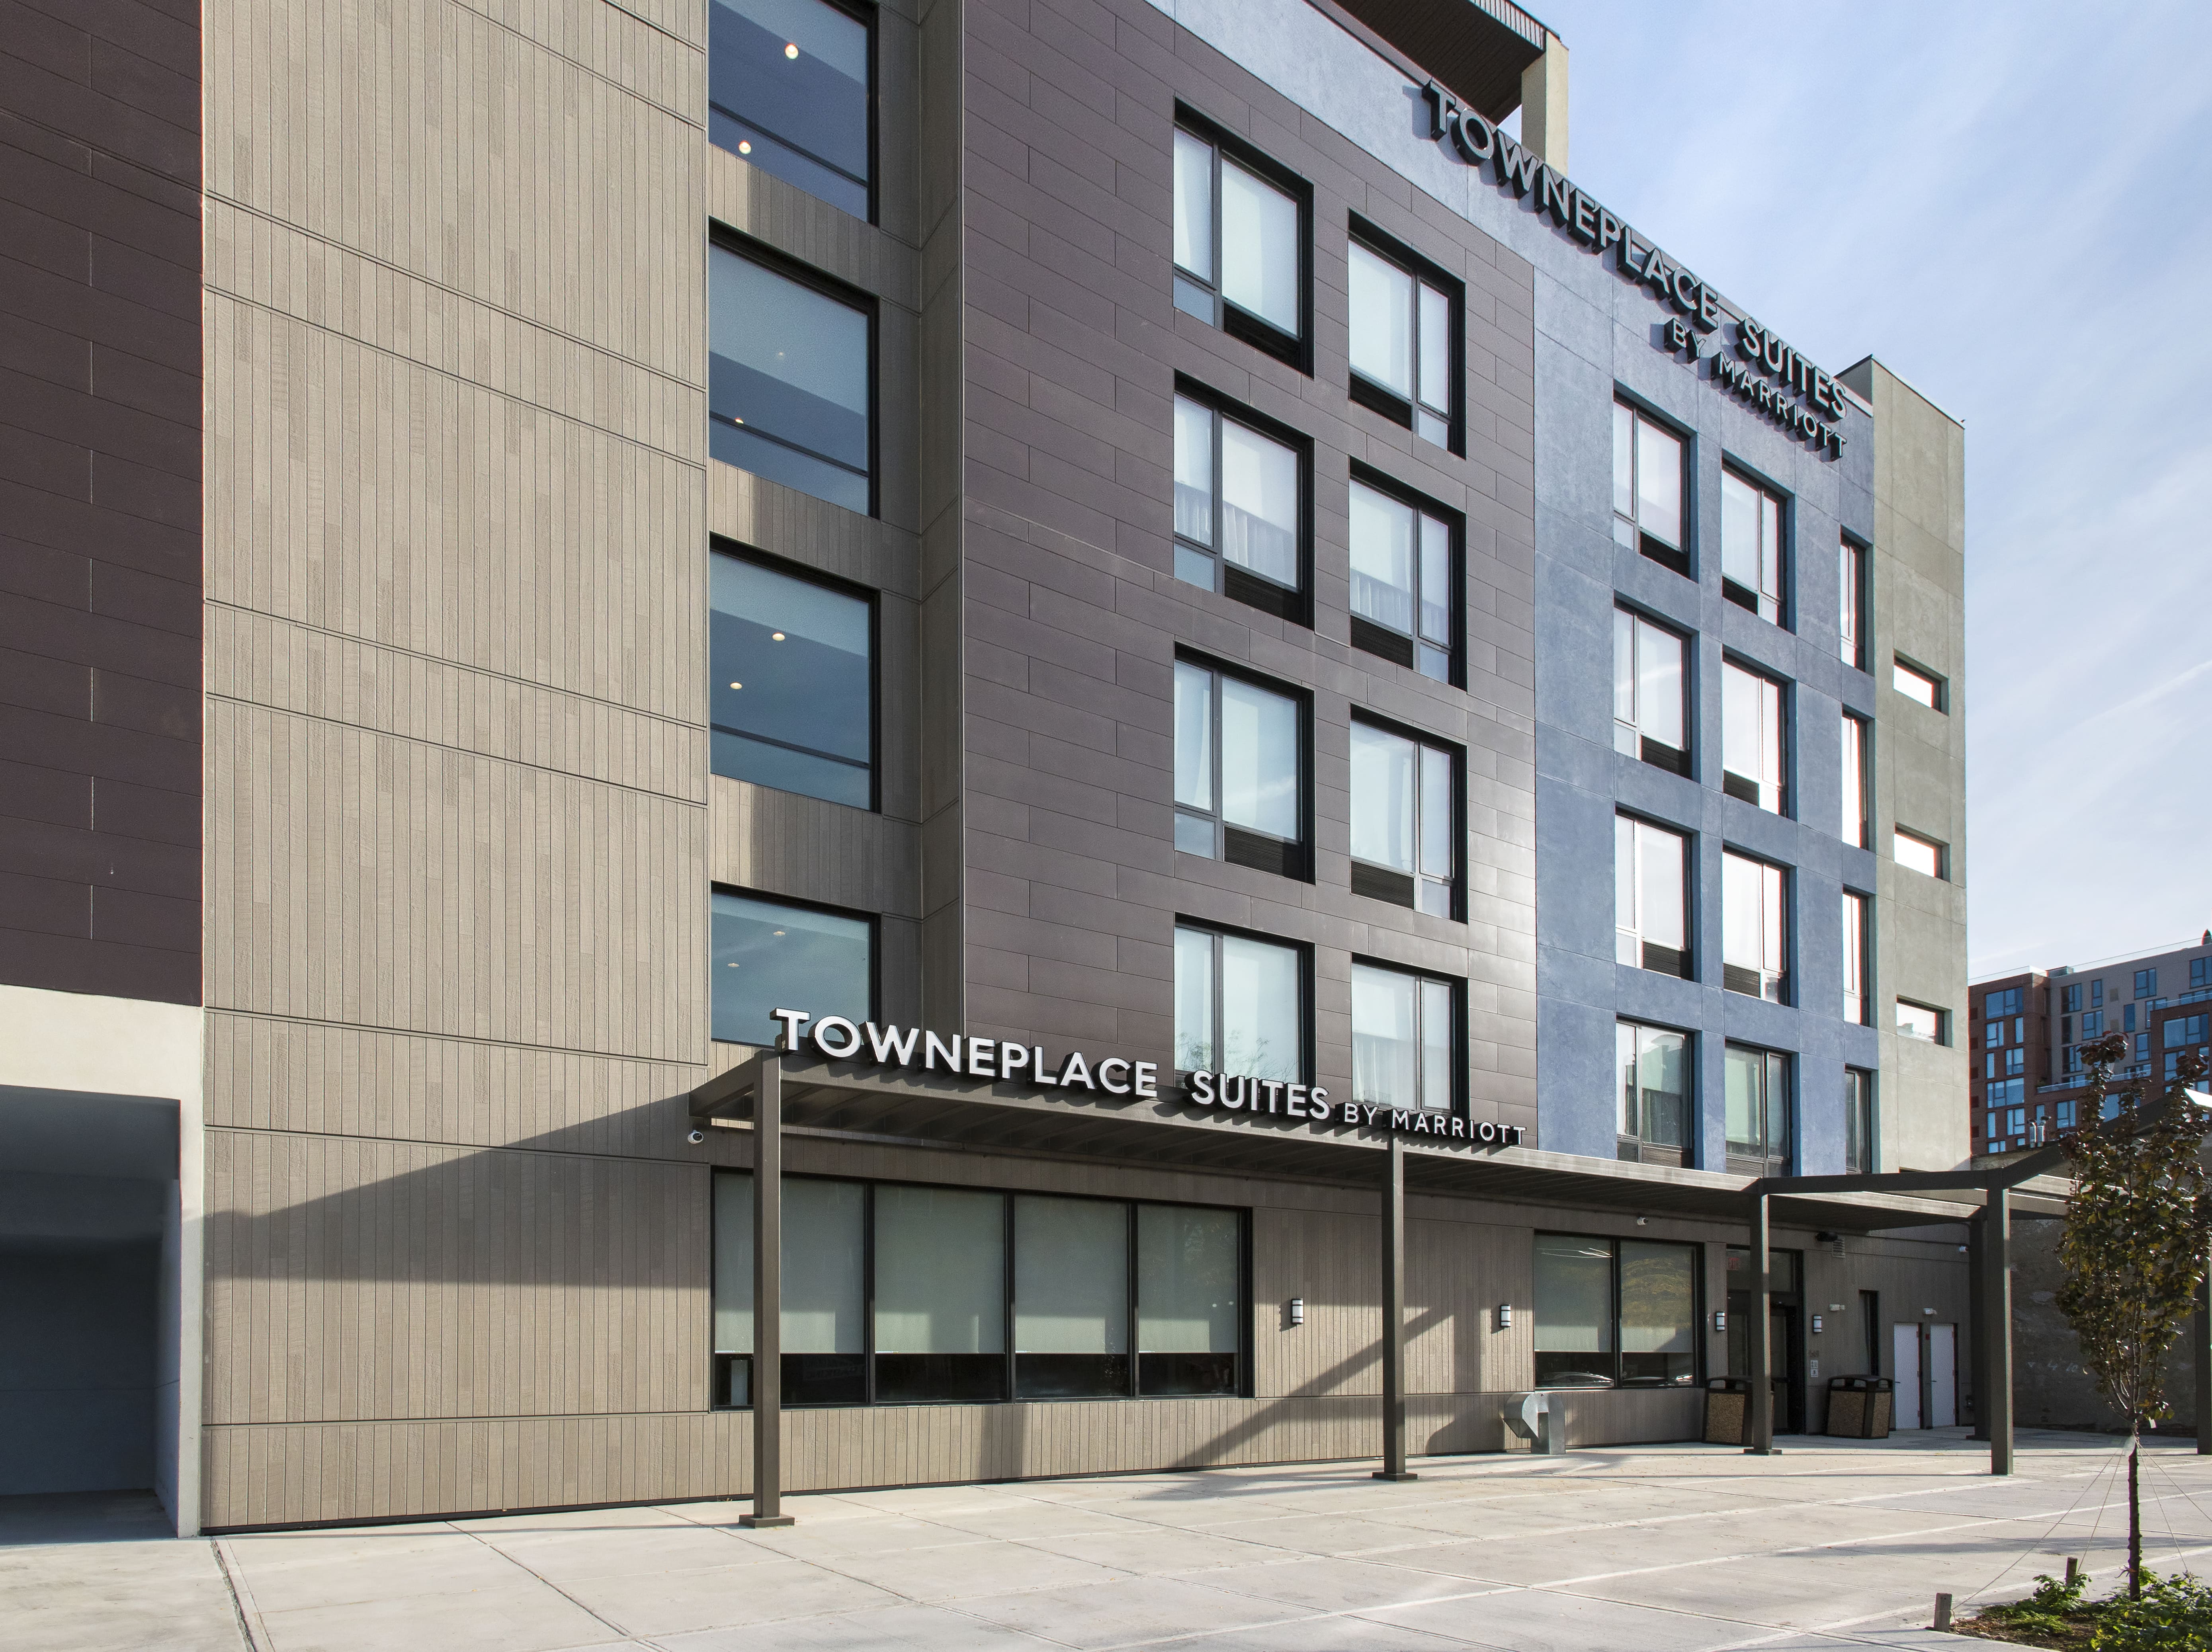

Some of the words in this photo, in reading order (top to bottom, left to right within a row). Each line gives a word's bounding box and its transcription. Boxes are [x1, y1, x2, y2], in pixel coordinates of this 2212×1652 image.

[1424, 80, 1718, 334] TOWNEPLACE
[1738, 317, 1847, 420] SUITES
[1668, 318, 1706, 361] BY
[1714, 352, 1847, 459] MARRIOTT
[772, 1008, 1157, 1098] TOWNEPLACE
[1188, 1069, 1331, 1120] SUITES
[1341, 1102, 1379, 1126] BY
[1391, 1109, 1527, 1145] MARRIOTT
